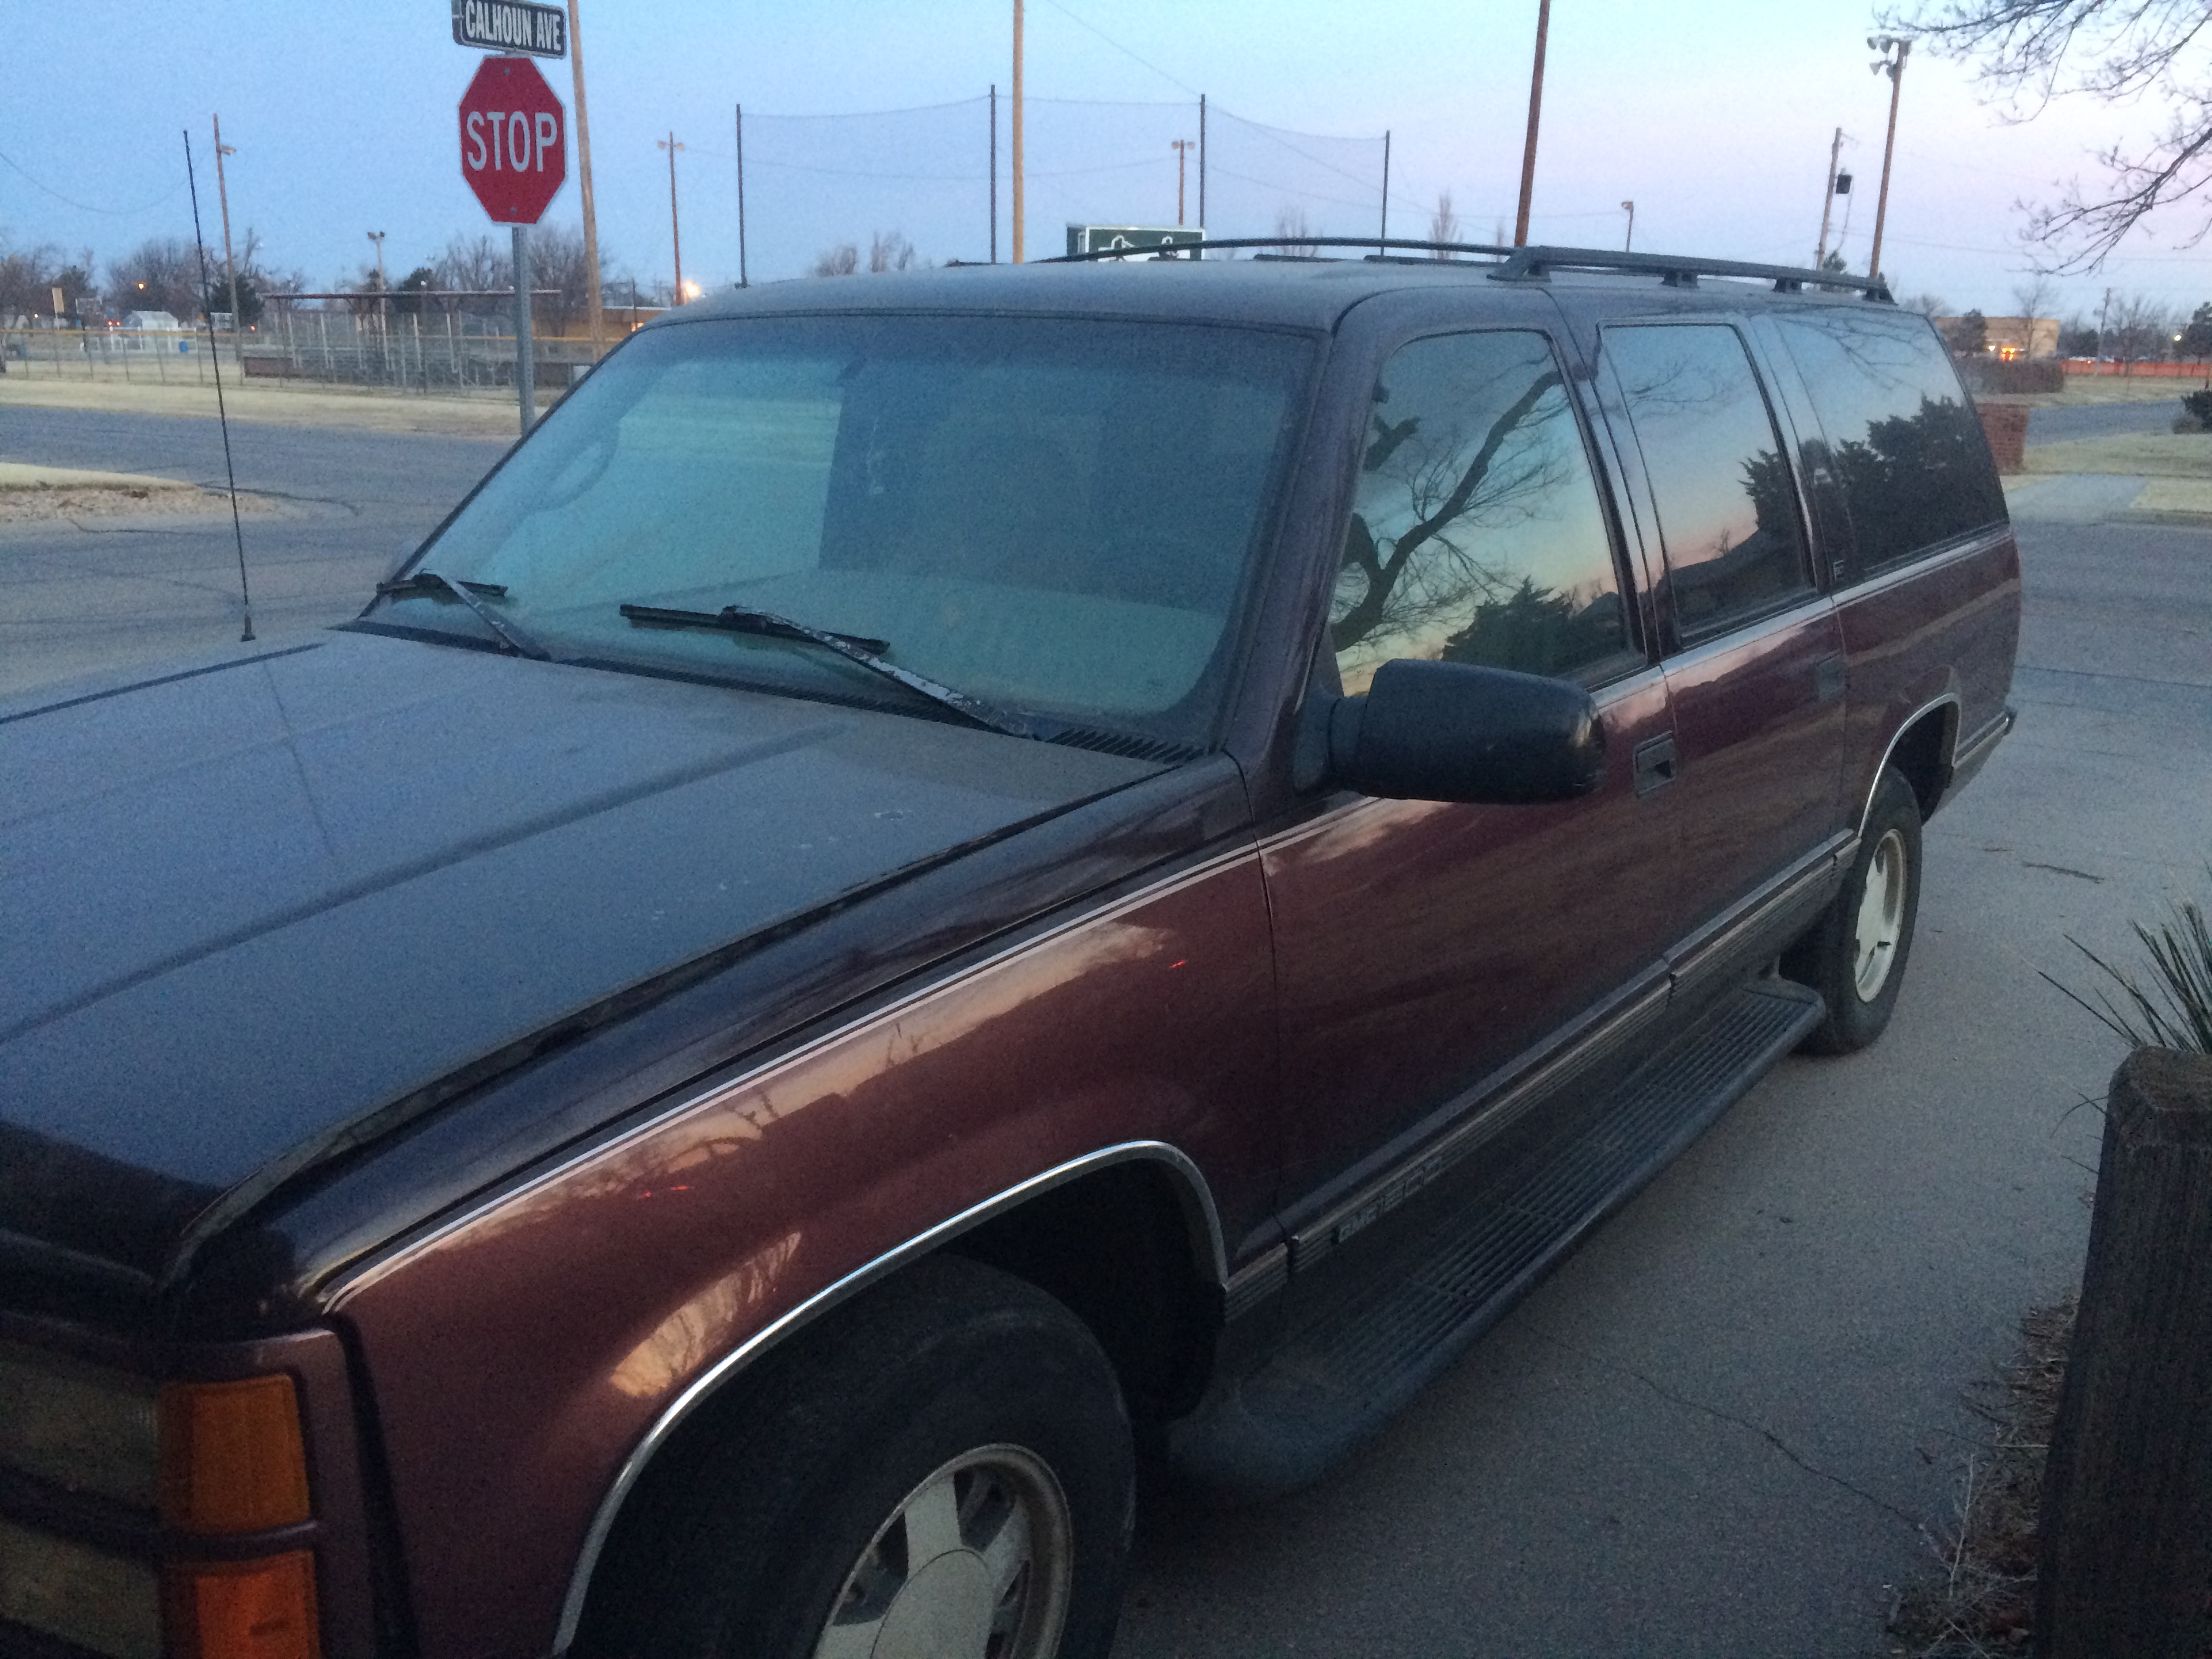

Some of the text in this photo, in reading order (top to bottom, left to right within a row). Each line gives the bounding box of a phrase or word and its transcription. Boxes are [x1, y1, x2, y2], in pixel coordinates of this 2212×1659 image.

[466, 0, 561, 51] CALHOUN AVE
[467, 110, 557, 171] STOP
